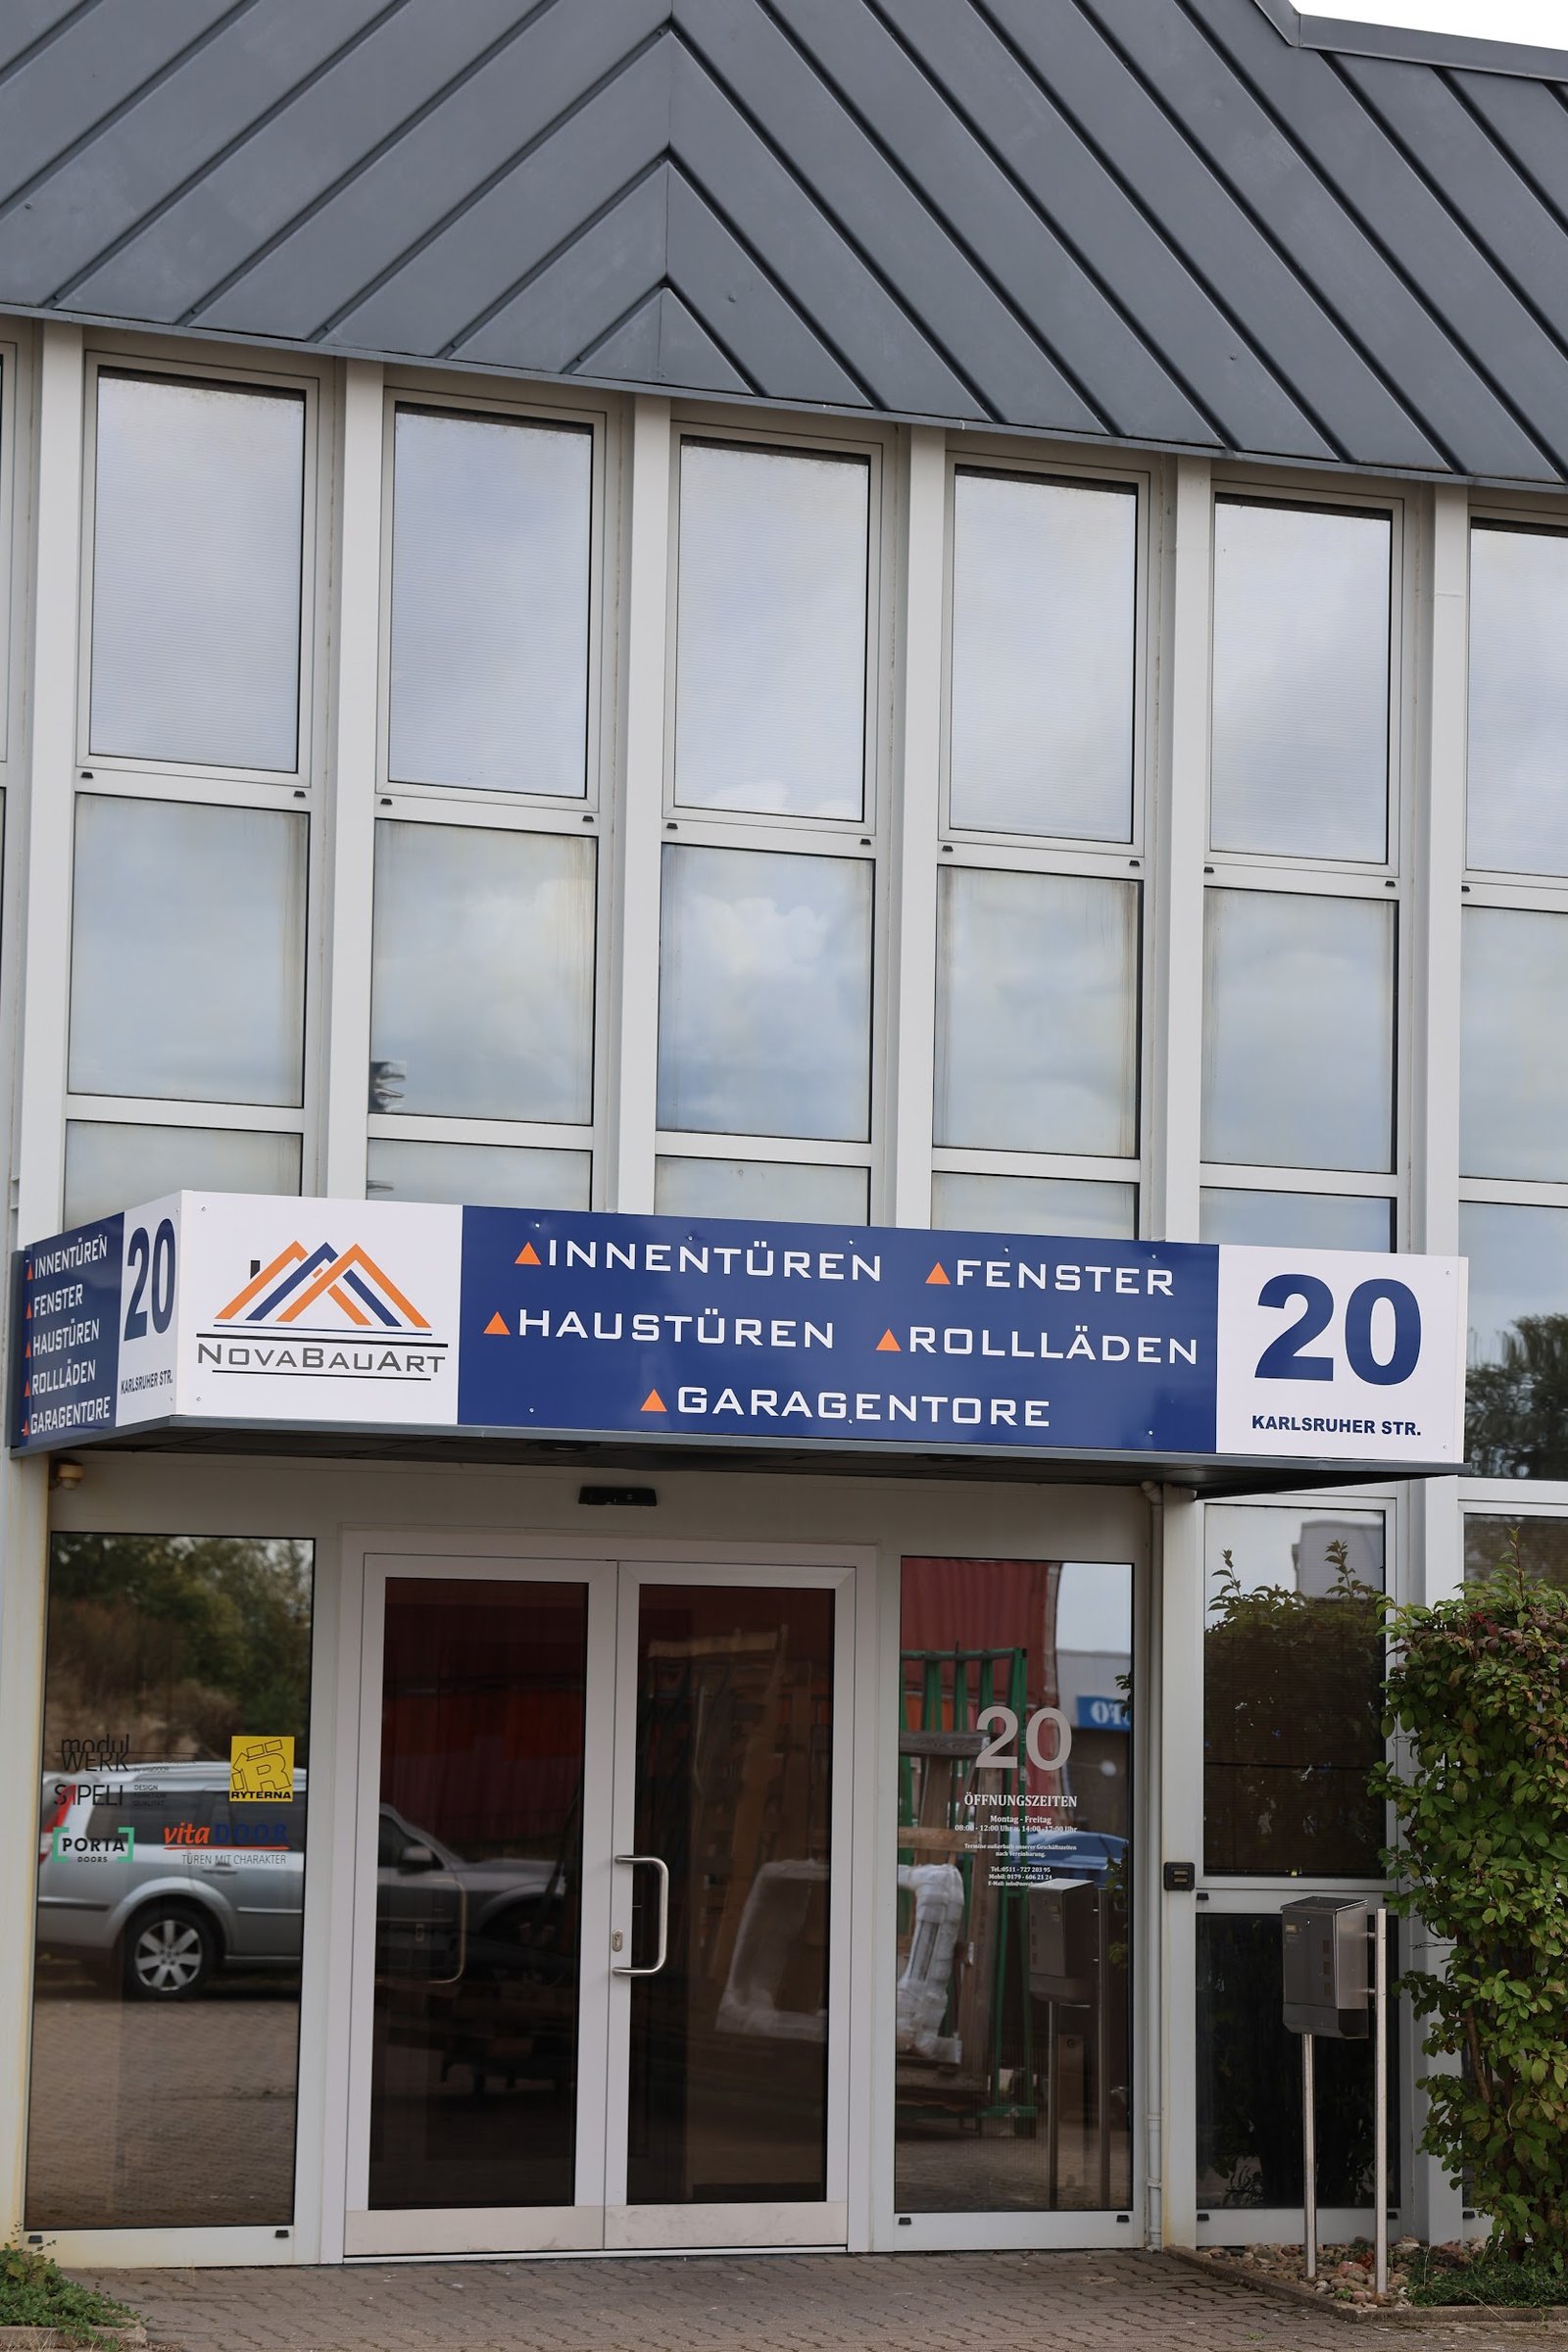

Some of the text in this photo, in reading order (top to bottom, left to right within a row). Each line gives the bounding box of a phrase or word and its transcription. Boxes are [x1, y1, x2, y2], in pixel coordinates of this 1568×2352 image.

[34, 1235, 108, 1279] INNENTÜREN
[549, 1239, 881, 1282] INNENTÜREN
[124, 1218, 175, 1341] 20
[956, 1259, 1174, 1296] FENSTER
[33, 1283, 83, 1318] FENSTER
[32, 1318, 100, 1356] HAUSTÜREN
[518, 1308, 833, 1348] HAUSTÜREN
[909, 1325, 1197, 1365] ROLLLÄDEN
[1254, 1273, 1421, 1386] 20
[31, 1359, 96, 1396] ROLLLÄDEN
[121, 1369, 173, 1395] KARLSRUHER STR.
[30, 1396, 111, 1435] GARAGENTORE
[678, 1387, 1050, 1427] GARAGENTORE
[1251, 1415, 1421, 1436] KARLSRUHER STR.
[61, 1734, 129, 1753] modul
[975, 1705, 1072, 1771] 20
[62, 1752, 129, 1772] WERK
[964, 1791, 1078, 1807] ÖFFNUNGSZEITEN
[990, 1815, 1019, 1825] Montag
[1024, 1815, 1052, 1825] Freitag
[62, 1838, 125, 1852] PORTA
[181, 1852, 287, 1865] TÜREN MIT CHARAKTER
